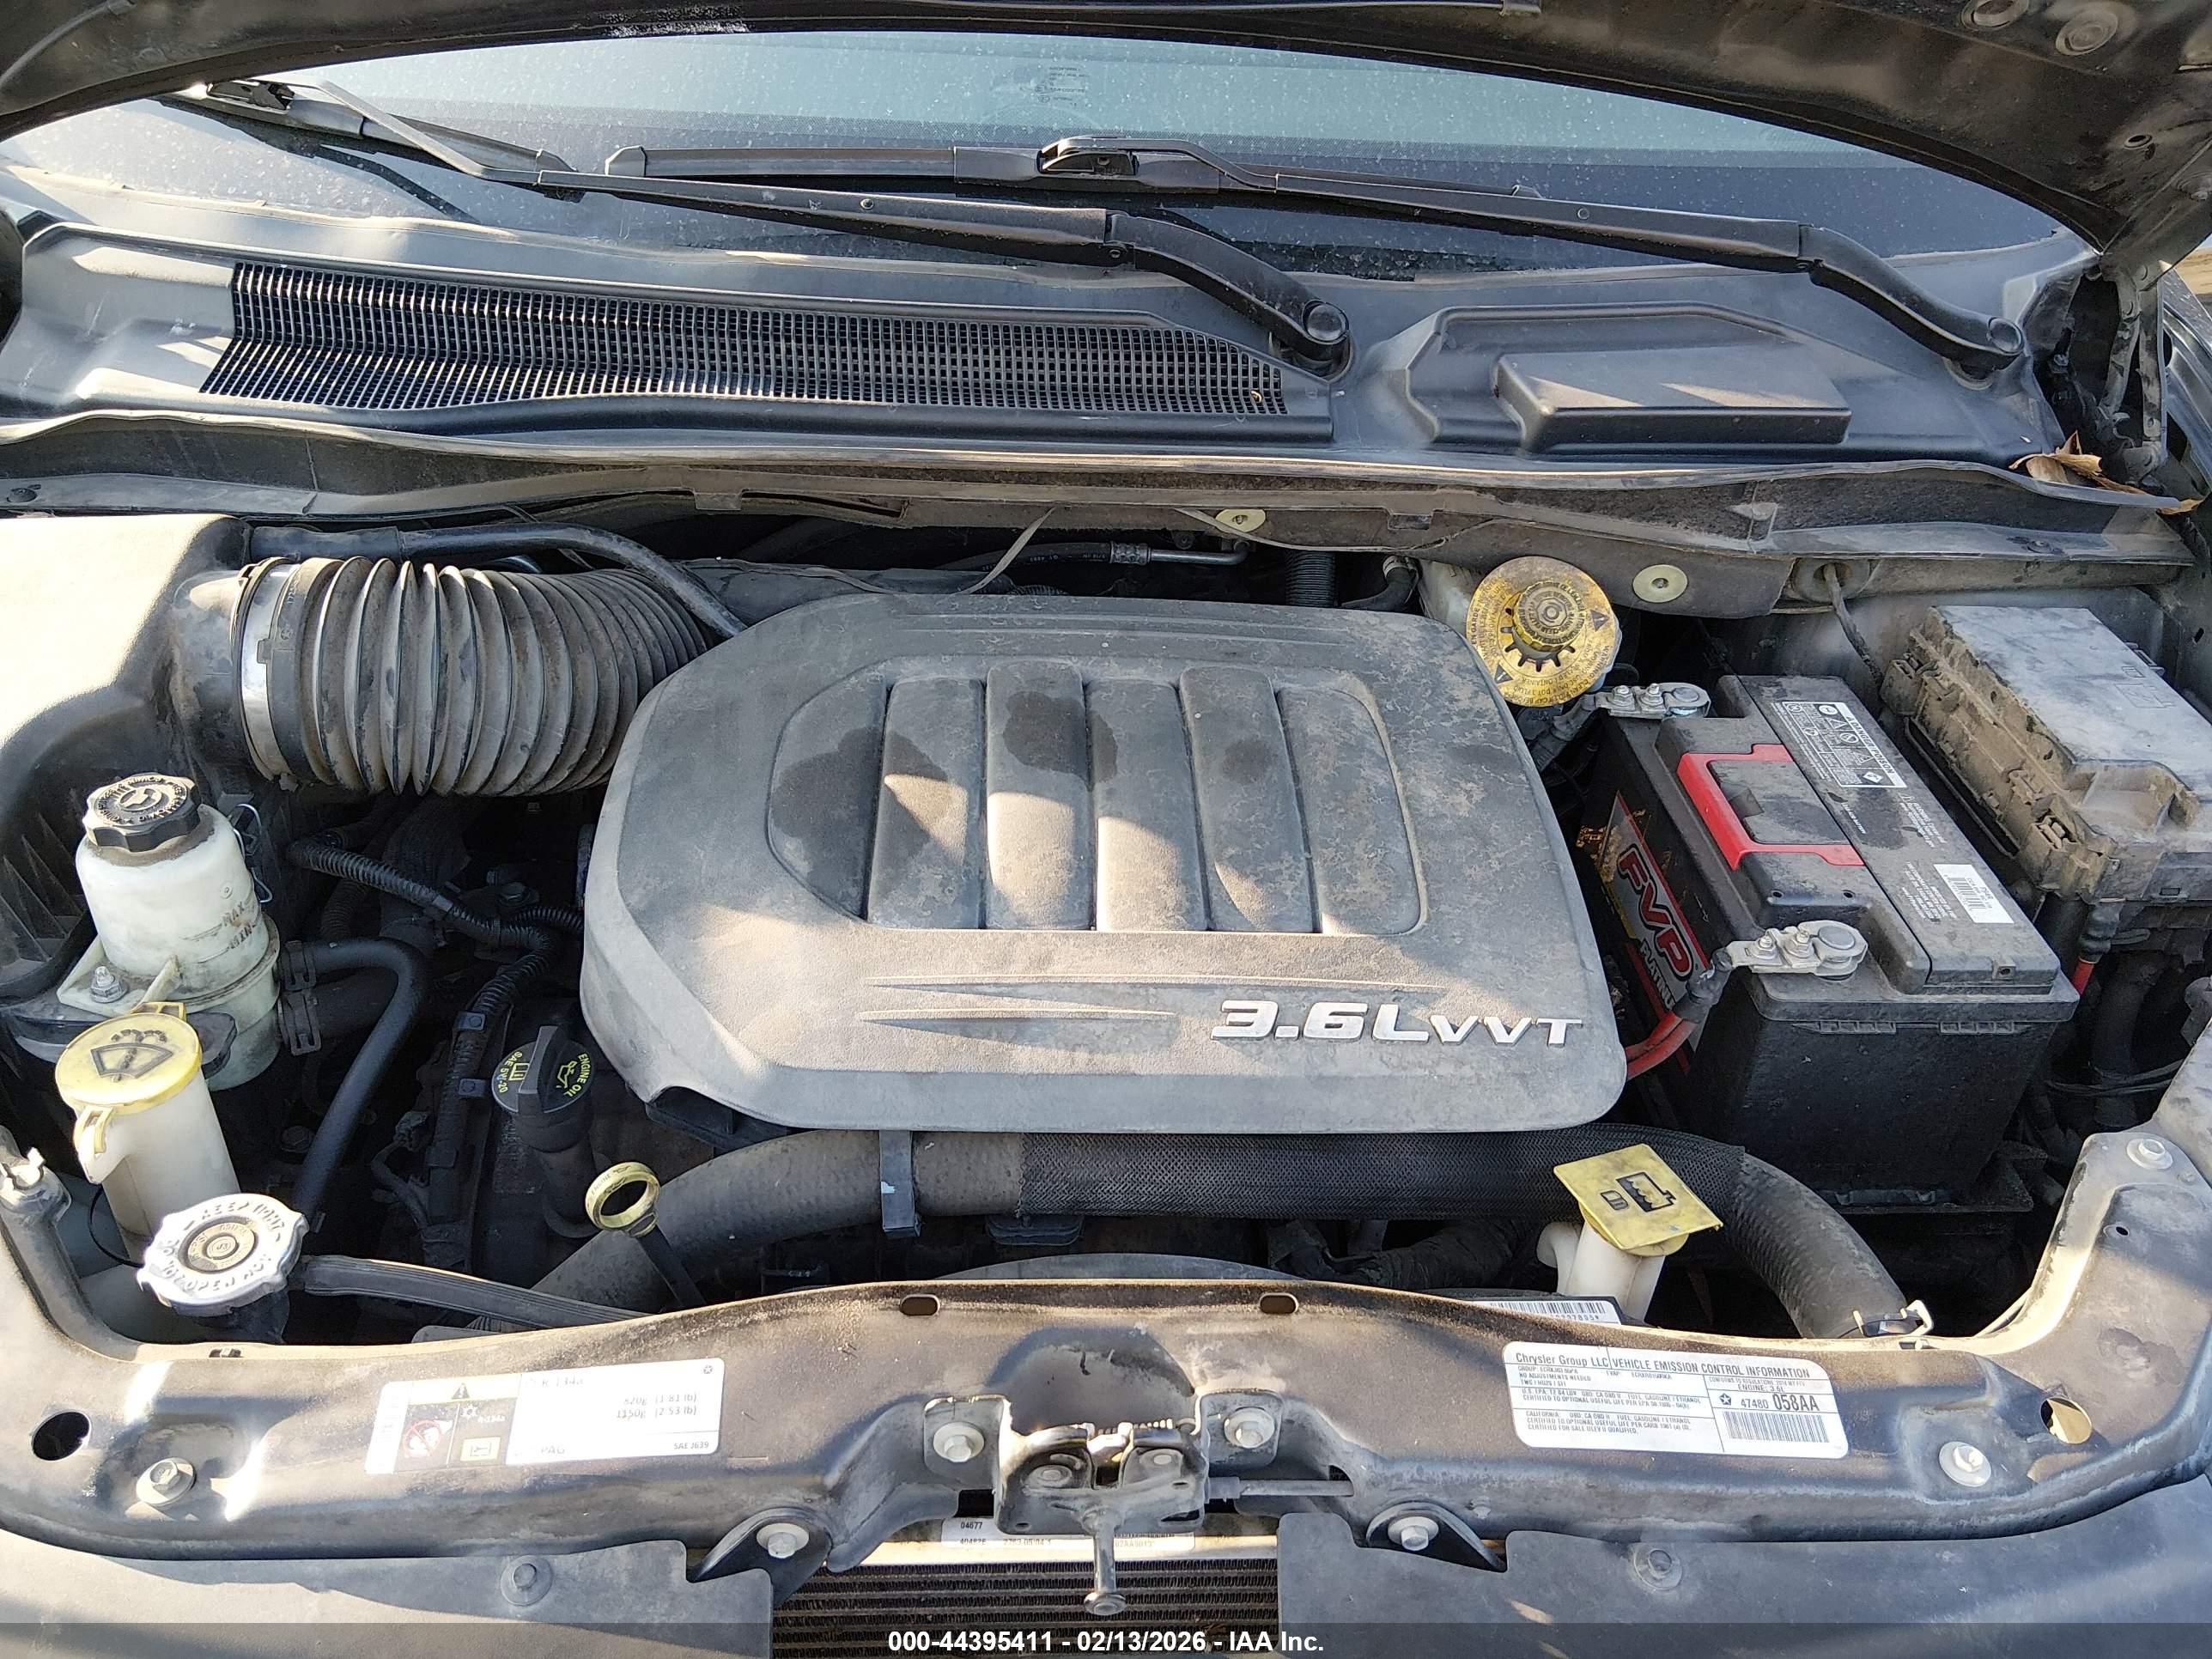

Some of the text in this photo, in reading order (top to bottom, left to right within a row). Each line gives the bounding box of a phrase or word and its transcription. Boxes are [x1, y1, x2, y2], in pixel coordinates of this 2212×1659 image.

[1470, 634, 1477, 645] EN
[222, 902, 246, 927] MAX
[1617, 844, 1693, 981] FVP
[1639, 938, 1675, 1010] PLATINU
[495, 1051, 522, 1093] SAE 5W-20
[563, 1053, 591, 1097] ENGINE OIL
[1516, 1352, 1609, 1367] Chrysler Group LLC
[1612, 1358, 1810, 1378] VEHICLE EMISSION CONTROL INFORMATION
[655, 1394, 679, 1404] (181
[1771, 1394, 1820, 1411] 058AA
[655, 1407, 680, 1419] (253
